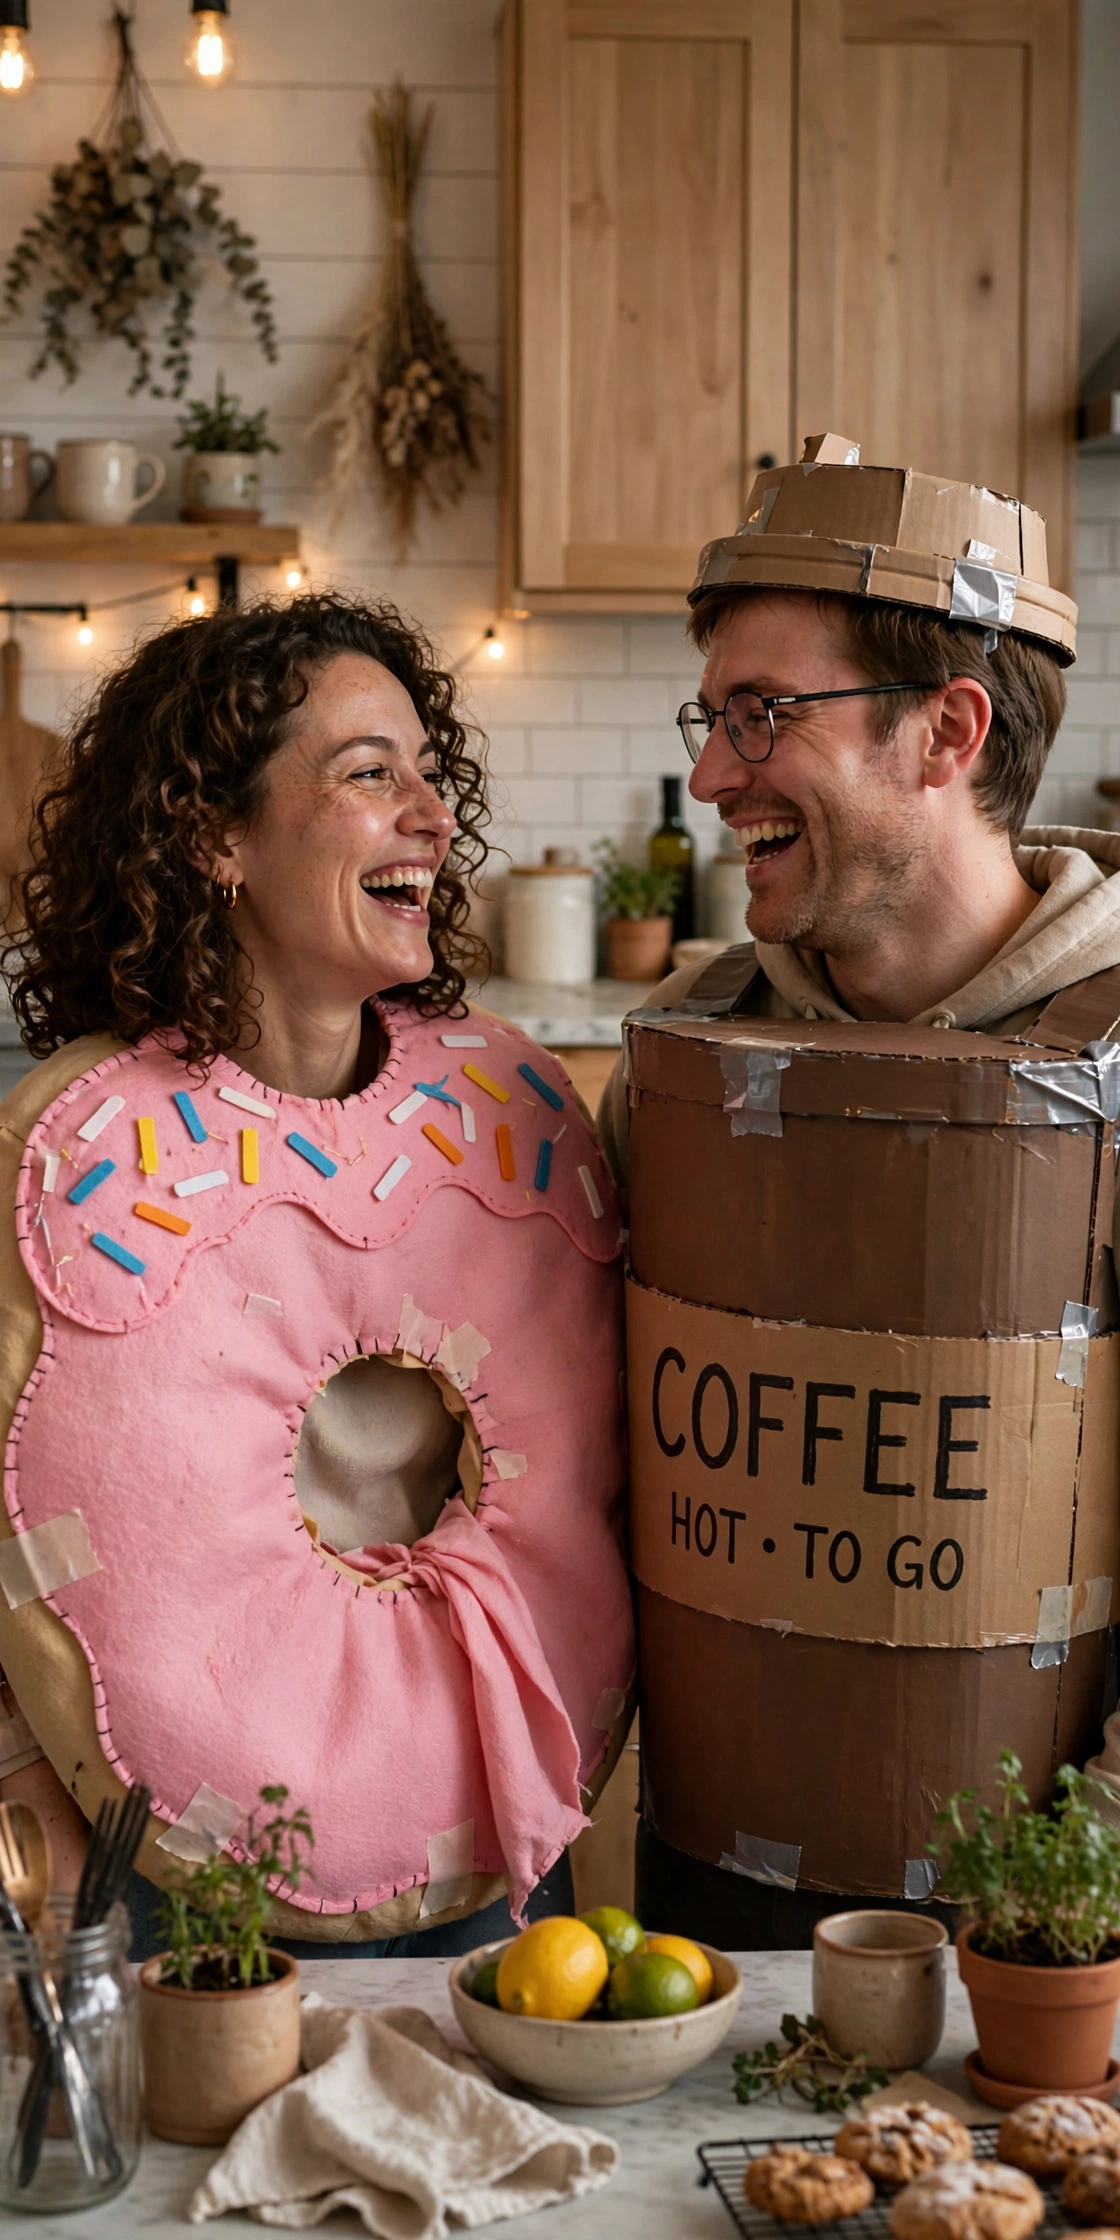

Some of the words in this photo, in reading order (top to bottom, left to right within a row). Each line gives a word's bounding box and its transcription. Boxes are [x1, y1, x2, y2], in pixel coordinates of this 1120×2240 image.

[652, 1346, 991, 1500] COFFEE
[671, 1491, 747, 1564] HOT
[793, 1523, 861, 1583] TO
[886, 1535, 964, 1591] GO
